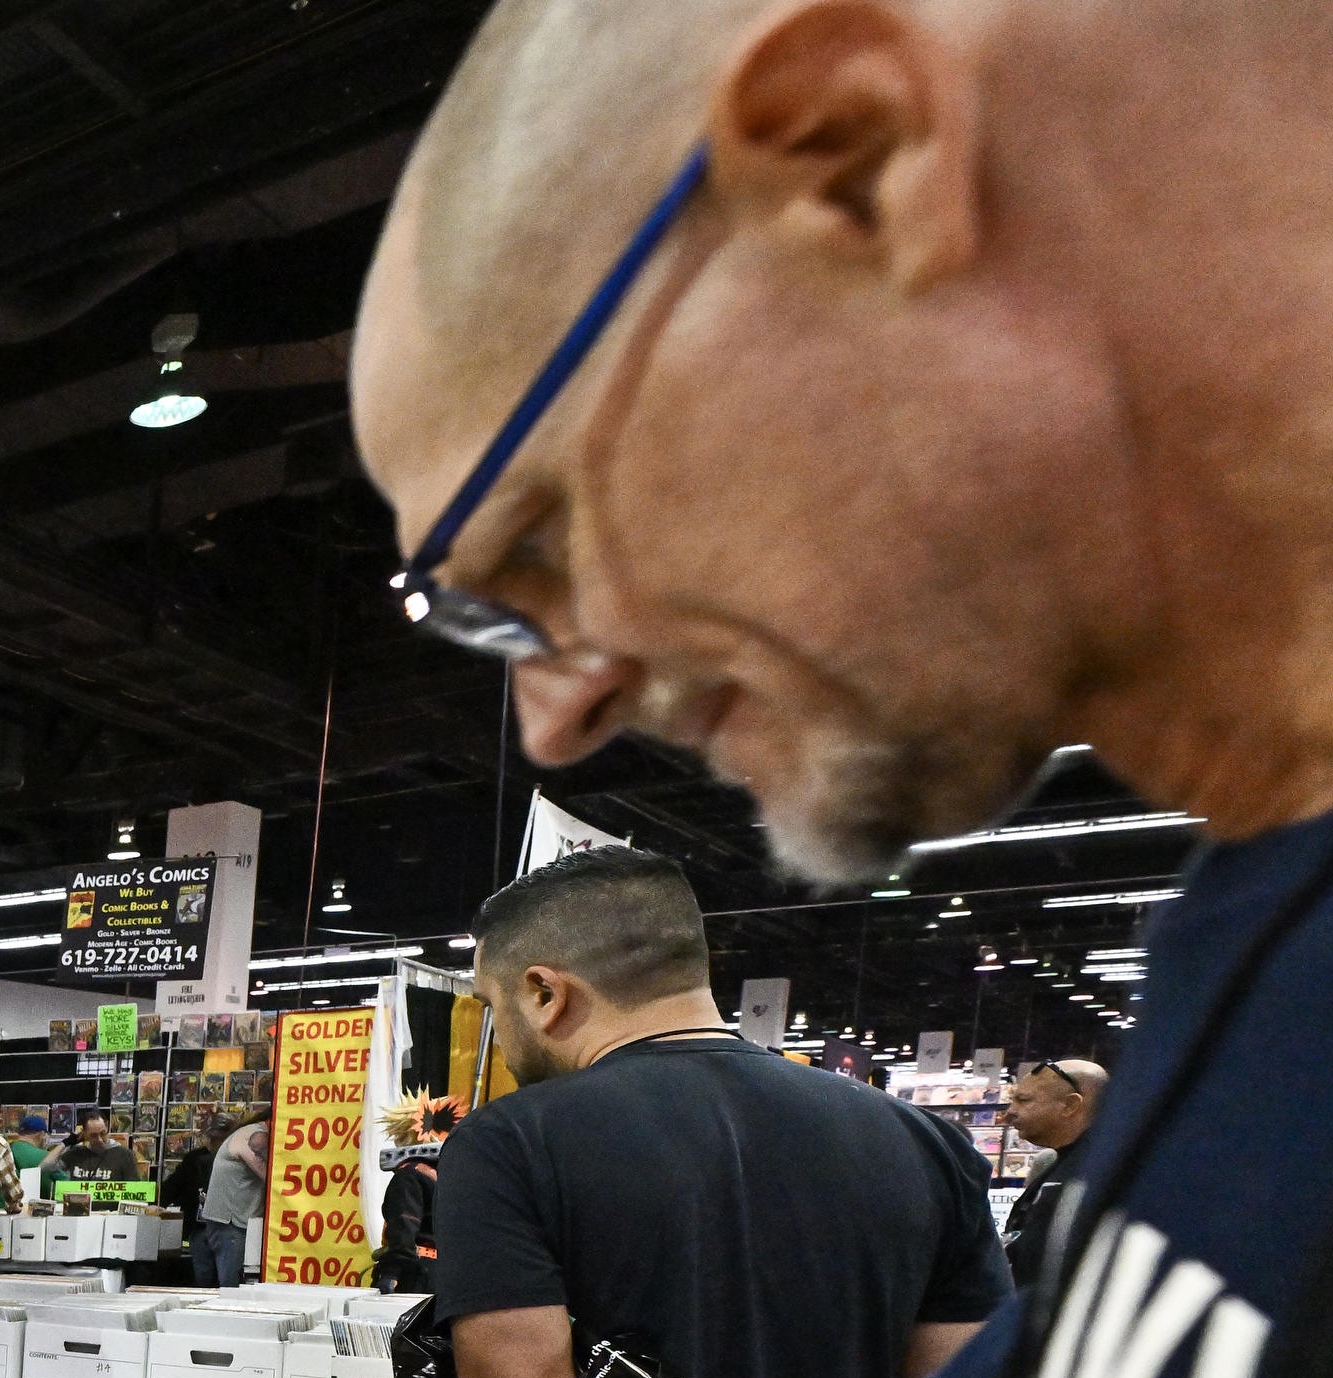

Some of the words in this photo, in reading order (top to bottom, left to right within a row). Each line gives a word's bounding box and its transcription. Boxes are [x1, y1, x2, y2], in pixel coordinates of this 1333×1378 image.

[150, 866, 209, 883] COMICS
[136, 888, 154, 897] BUY
[130, 903, 158, 911] BOOKS
[161, 900, 169, 910] &
[107, 917, 162, 926] COLLECTIBLES
[61, 946, 197, 966] 619-727-0414
[279, 1210, 364, 1243] 50%
